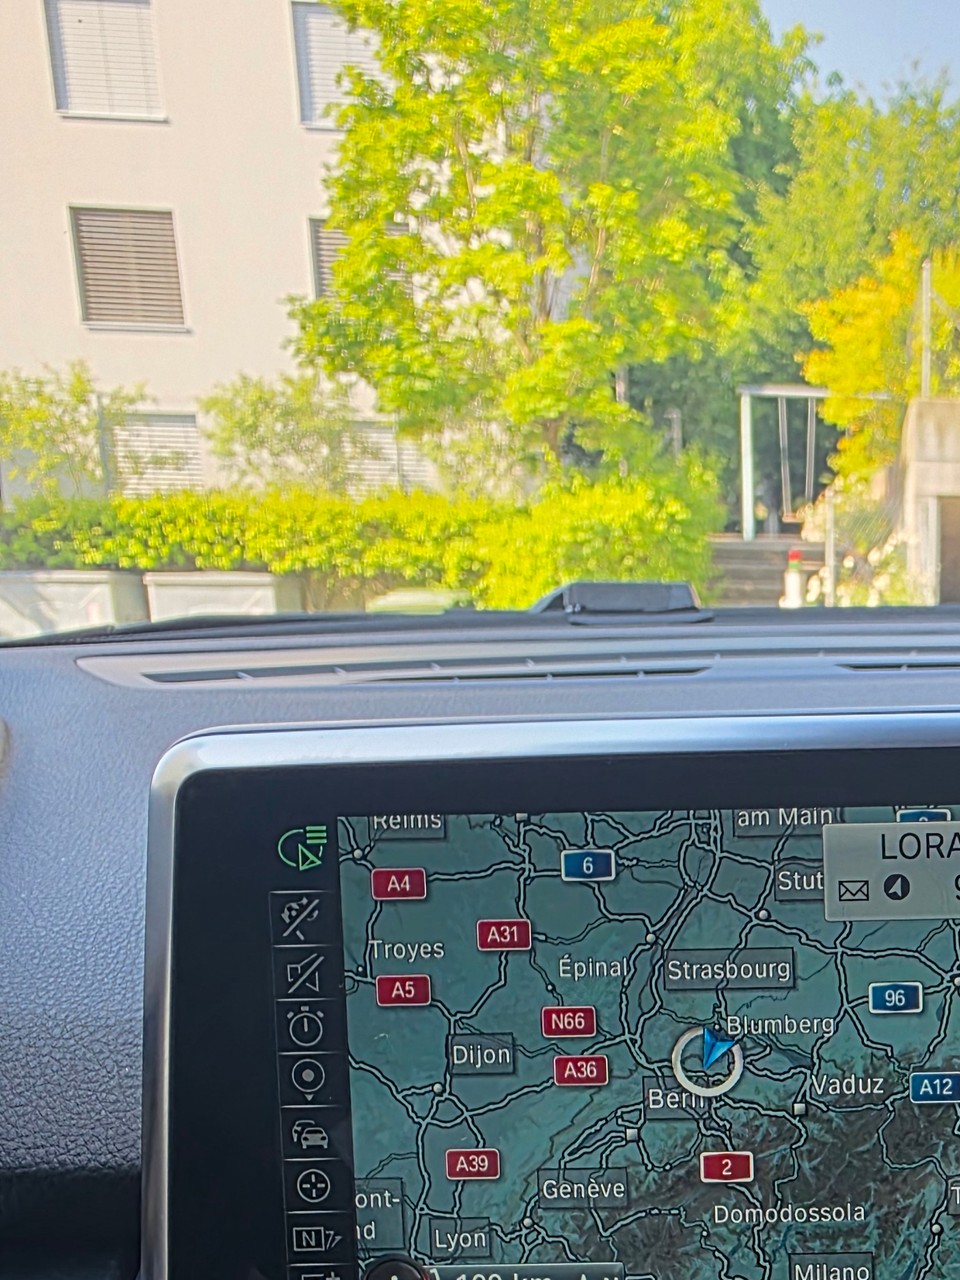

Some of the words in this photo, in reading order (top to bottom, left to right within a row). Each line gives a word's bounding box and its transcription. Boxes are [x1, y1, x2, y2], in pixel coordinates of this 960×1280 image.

[737, 810, 770, 827] am
[778, 807, 833, 825] Main
[582, 855, 595, 876] 6
[386, 874, 412, 893] A4
[777, 869, 825, 892] Stut
[486, 924, 519, 944] A31
[369, 939, 446, 963] Troyes
[558, 954, 629, 979] Épinal
[667, 961, 791, 984] Strasbourg
[391, 981, 416, 1000] A5
[885, 990, 906, 1007] 96
[550, 1011, 586, 1032] N66
[726, 1015, 835, 1036] Blumberg
[452, 1045, 511, 1067] Dijon
[563, 1060, 597, 1079] A36
[811, 1074, 885, 1096] Vaduz
[919, 1078, 954, 1096] A12
[455, 1153, 490, 1173] A39
[720, 1158, 733, 1176] 2
[541, 1179, 626, 1203] Genève
[713, 1203, 866, 1226] Domodossola
[434, 1230, 488, 1254] Lyon
